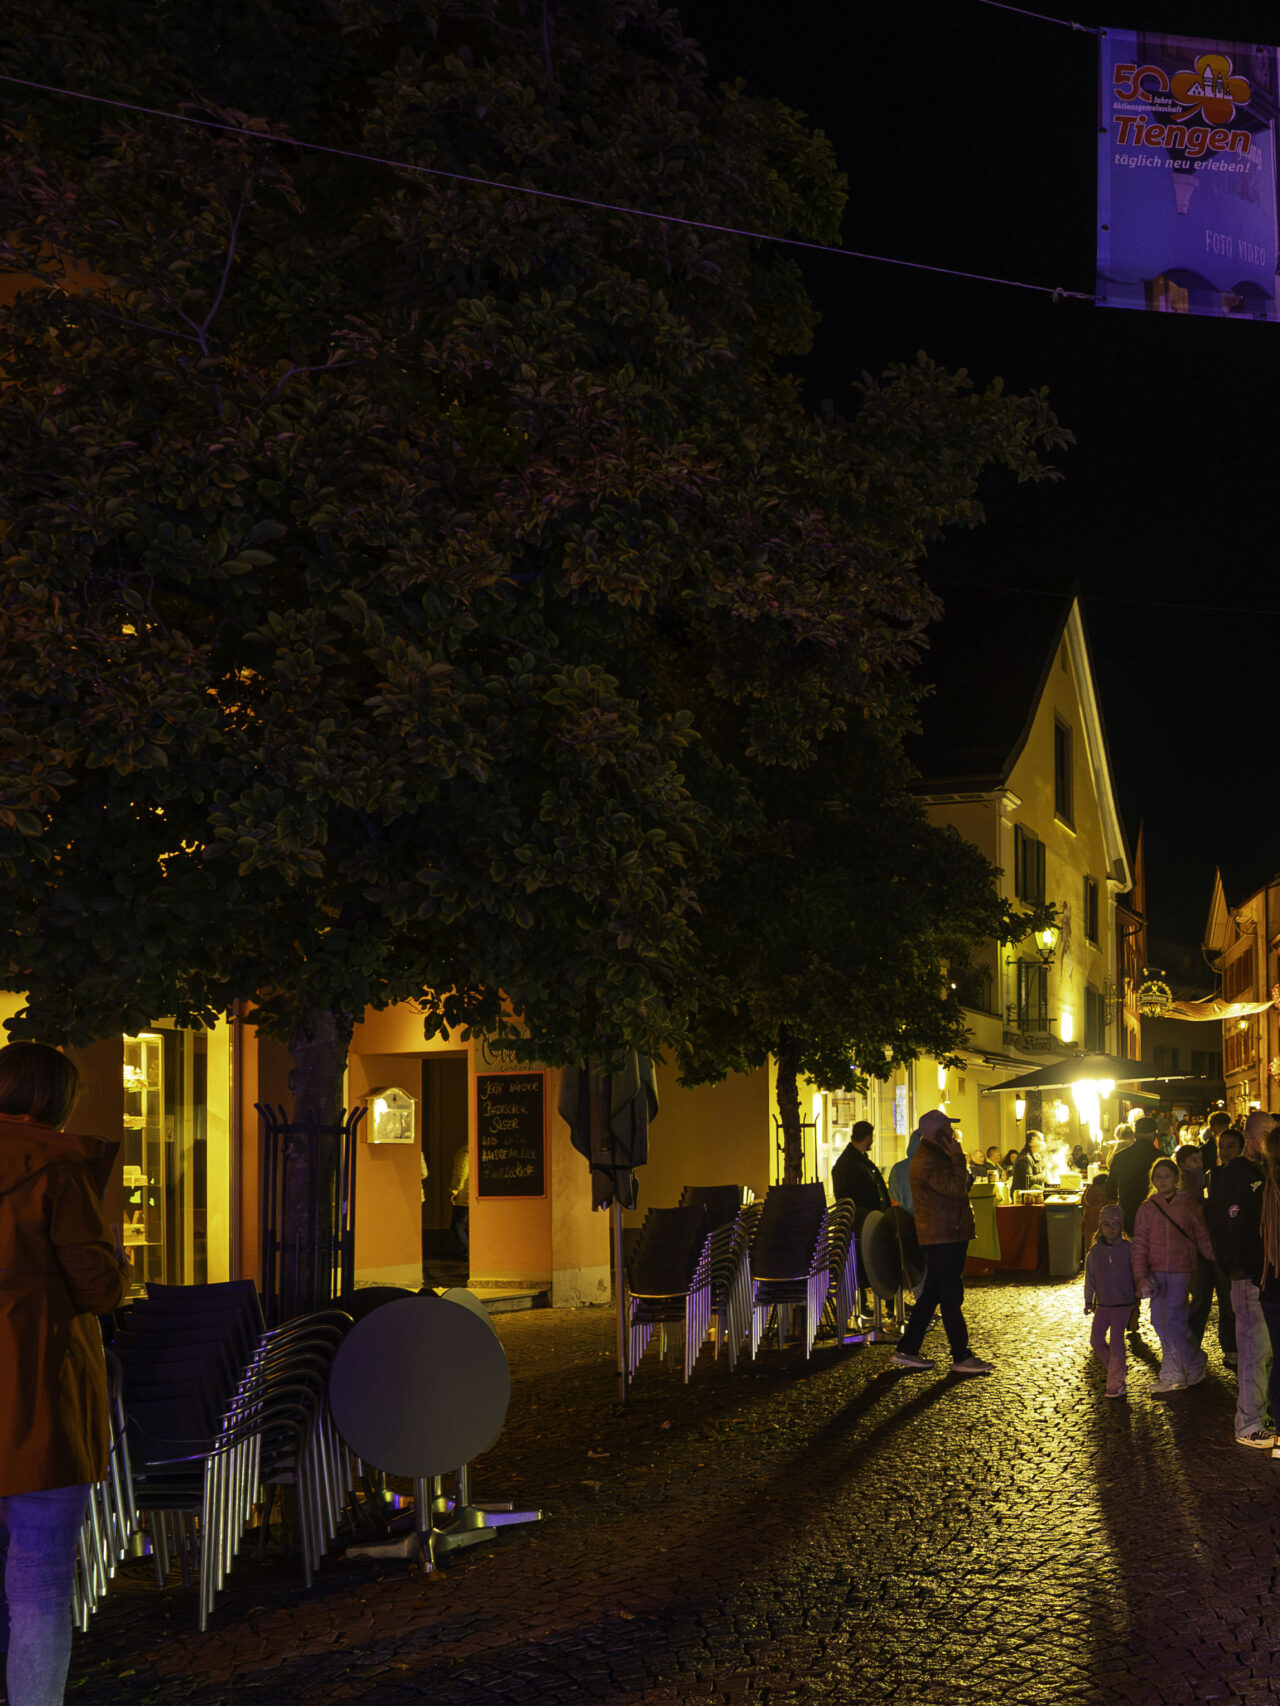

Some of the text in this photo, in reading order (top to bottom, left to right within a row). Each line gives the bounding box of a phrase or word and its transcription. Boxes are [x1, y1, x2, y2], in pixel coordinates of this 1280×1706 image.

[1113, 114, 1252, 157] Tiengen
[1115, 153, 1250, 173] täglich neu erleben!
[1206, 230, 1266, 266] FOTO VIDEO
